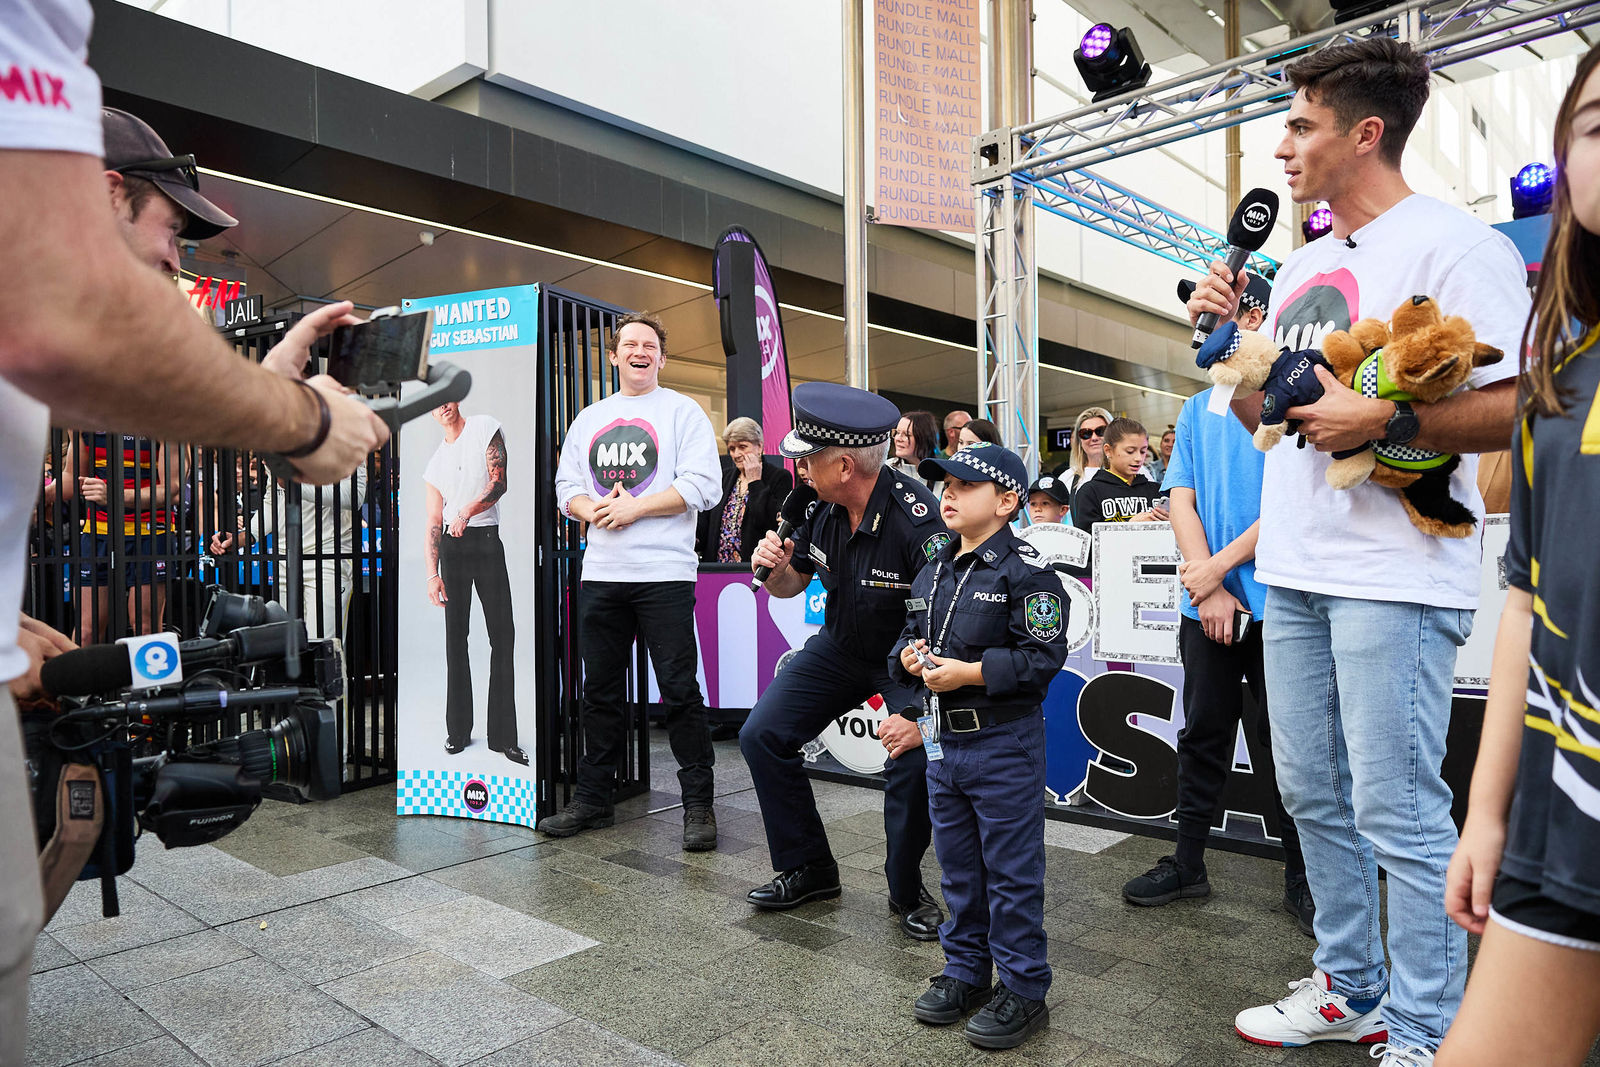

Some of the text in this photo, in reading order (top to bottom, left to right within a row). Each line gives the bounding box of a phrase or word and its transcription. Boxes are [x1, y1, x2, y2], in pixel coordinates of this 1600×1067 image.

[878, 0, 975, 28] RUNDLE MALL
[878, 14, 930, 37] RUNDLE
[878, 33, 976, 64] RUNDLE MALL
[879, 52, 930, 75] RUNDLE
[0, 65, 72, 110] MIX
[879, 71, 931, 93] RUNDLE
[879, 90, 977, 118] RUNDLE MALL
[880, 128, 969, 154] RUNDLE MAL
[880, 147, 969, 173] RUNDLE MAL
[880, 166, 936, 187] RUNDLE
[880, 185, 974, 210] RUNDLE MALL
[880, 204, 975, 228] RUNDLE MALL
[1246, 209, 1267, 222] MIX
[187, 275, 240, 310] H&M
[227, 299, 259, 325] JAIL
[435, 297, 511, 326] WANTED
[430, 324, 519, 348] GUY SEBASTIAN
[756, 315, 772, 342] IX
[597, 442, 647, 467] MIX
[602, 469, 637, 480] 102.3
[871, 568, 900, 580] POLICE
[973, 591, 1008, 603] POLICE
[1031, 626, 1059, 638] POLICE
[836, 716, 882, 740] YOU
[467, 789, 486, 801] MIX
[189, 813, 234, 825] FUJINON
